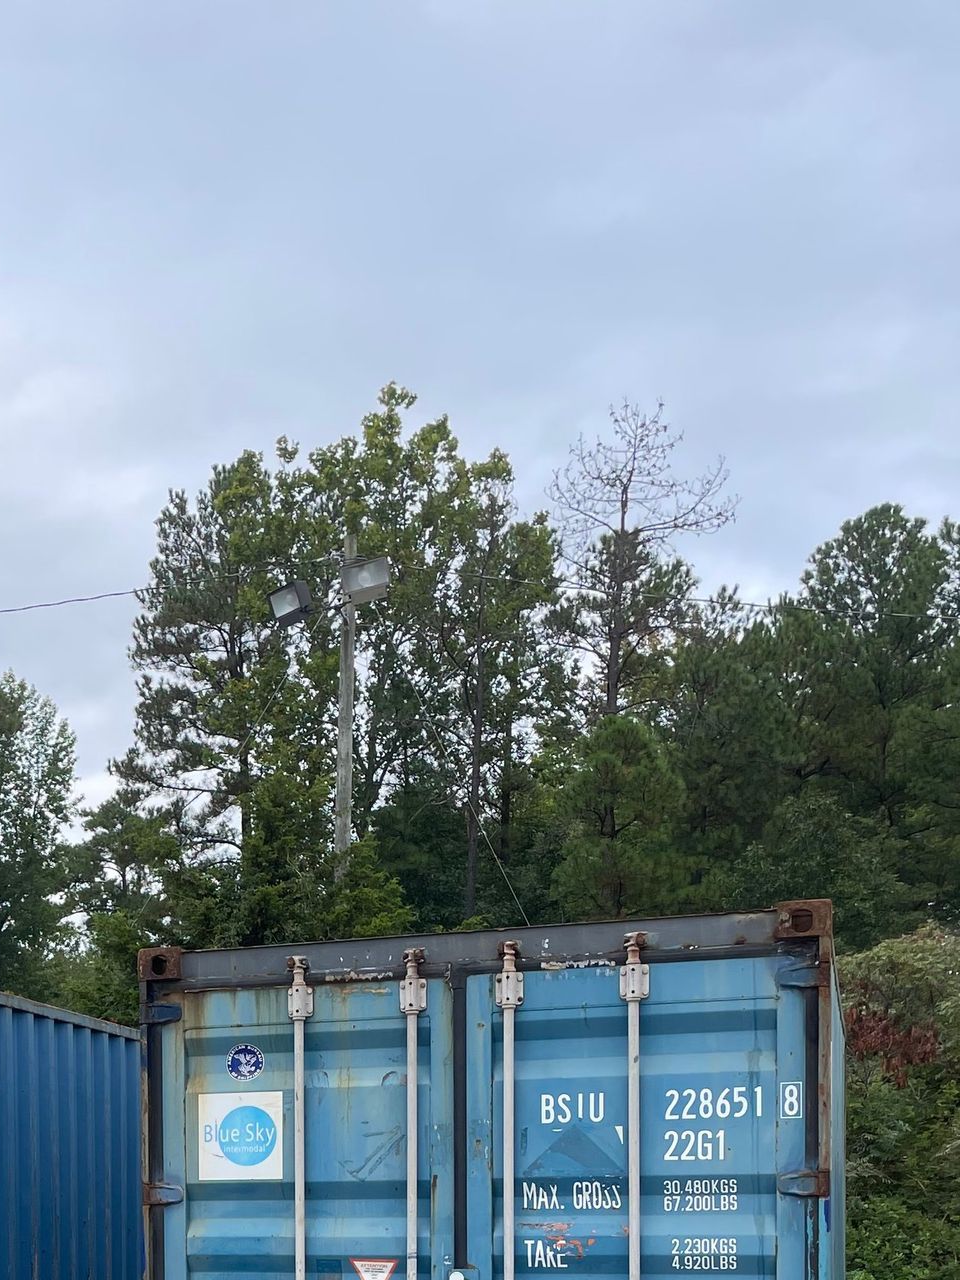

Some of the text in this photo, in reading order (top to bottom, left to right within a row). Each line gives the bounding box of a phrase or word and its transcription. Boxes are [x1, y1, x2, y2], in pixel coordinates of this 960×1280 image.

[541, 1085, 799, 1123] BSIU 228651 8
[204, 1120, 275, 1146] Blue Sky
[664, 1130, 725, 1161] 22G1
[224, 1145, 266, 1153] intermodal
[522, 1182, 565, 1210] MAX.
